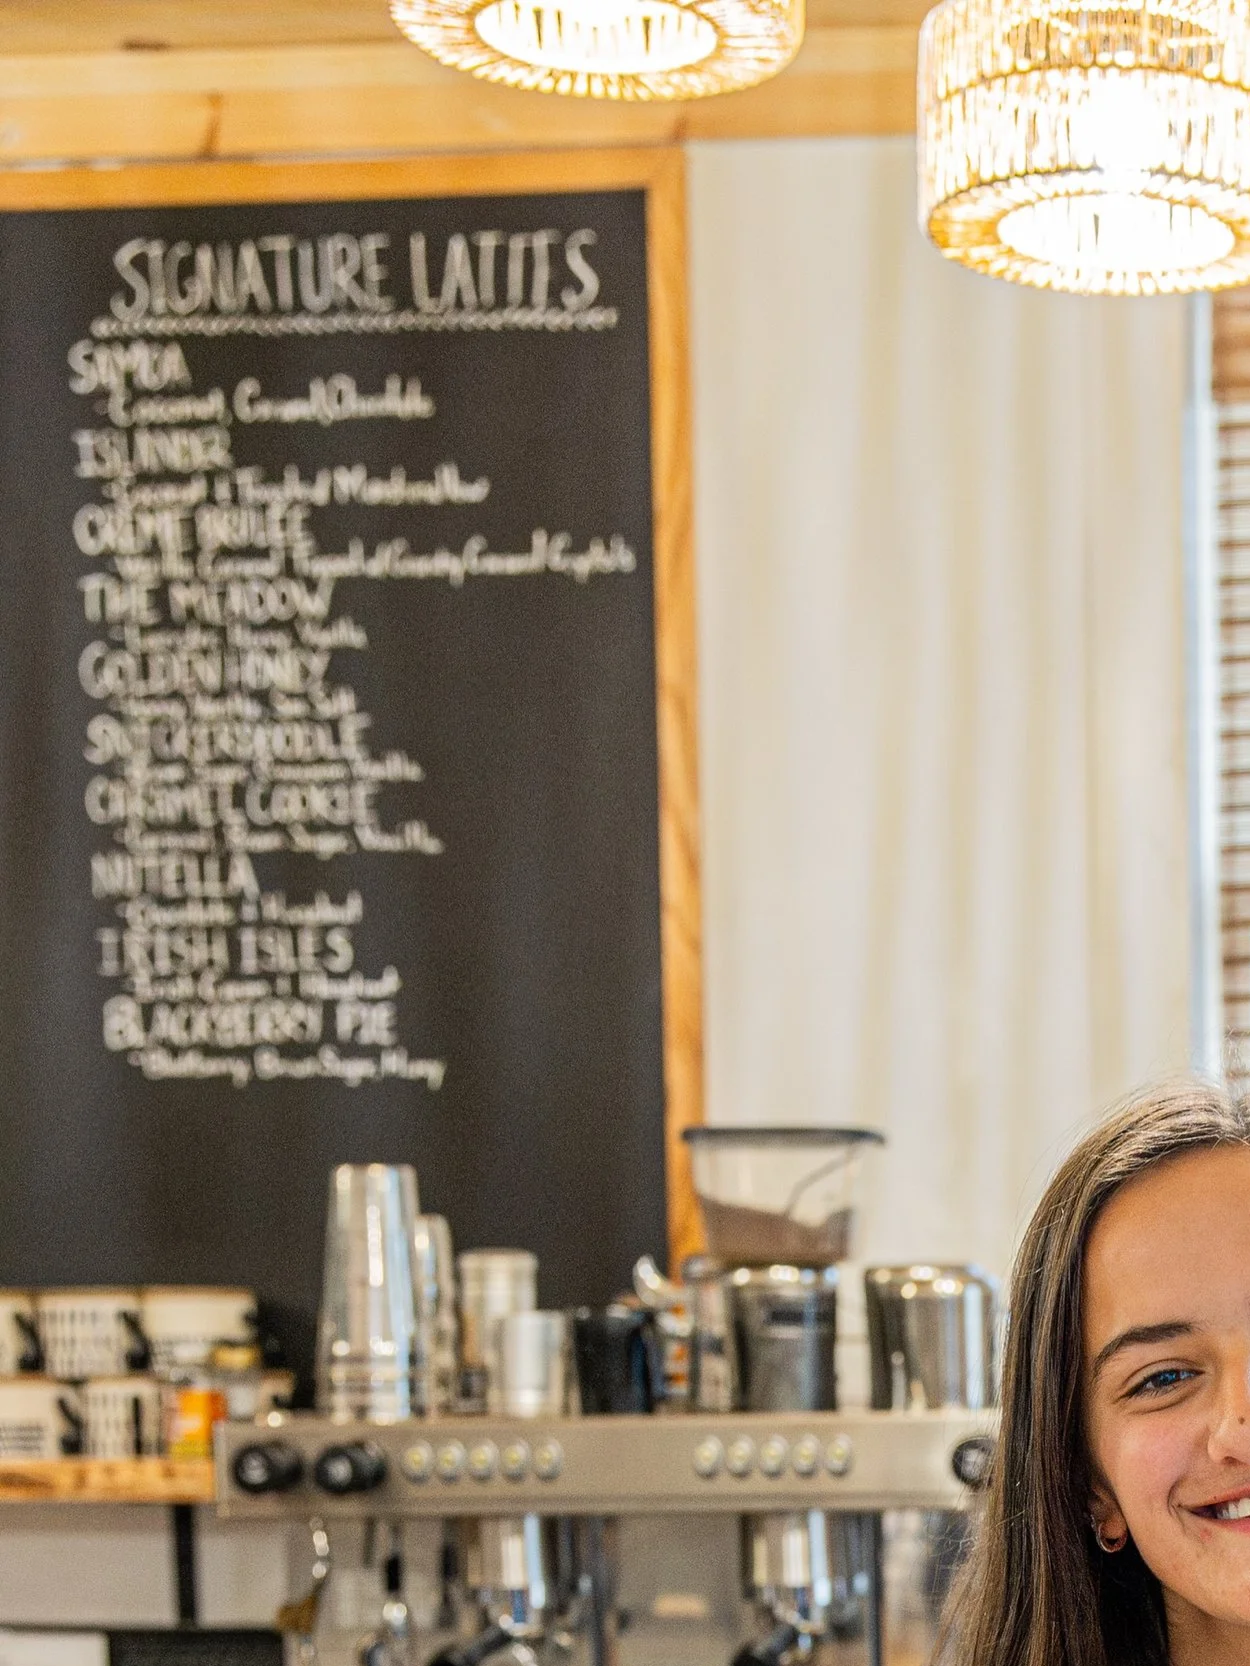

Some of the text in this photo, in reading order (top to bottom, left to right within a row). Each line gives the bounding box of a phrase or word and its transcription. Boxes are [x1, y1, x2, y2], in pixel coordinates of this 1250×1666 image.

[110, 233, 393, 321] SIGNATURE
[79, 573, 335, 625] THE MEADOW
[335, 999, 399, 1047] PIE
